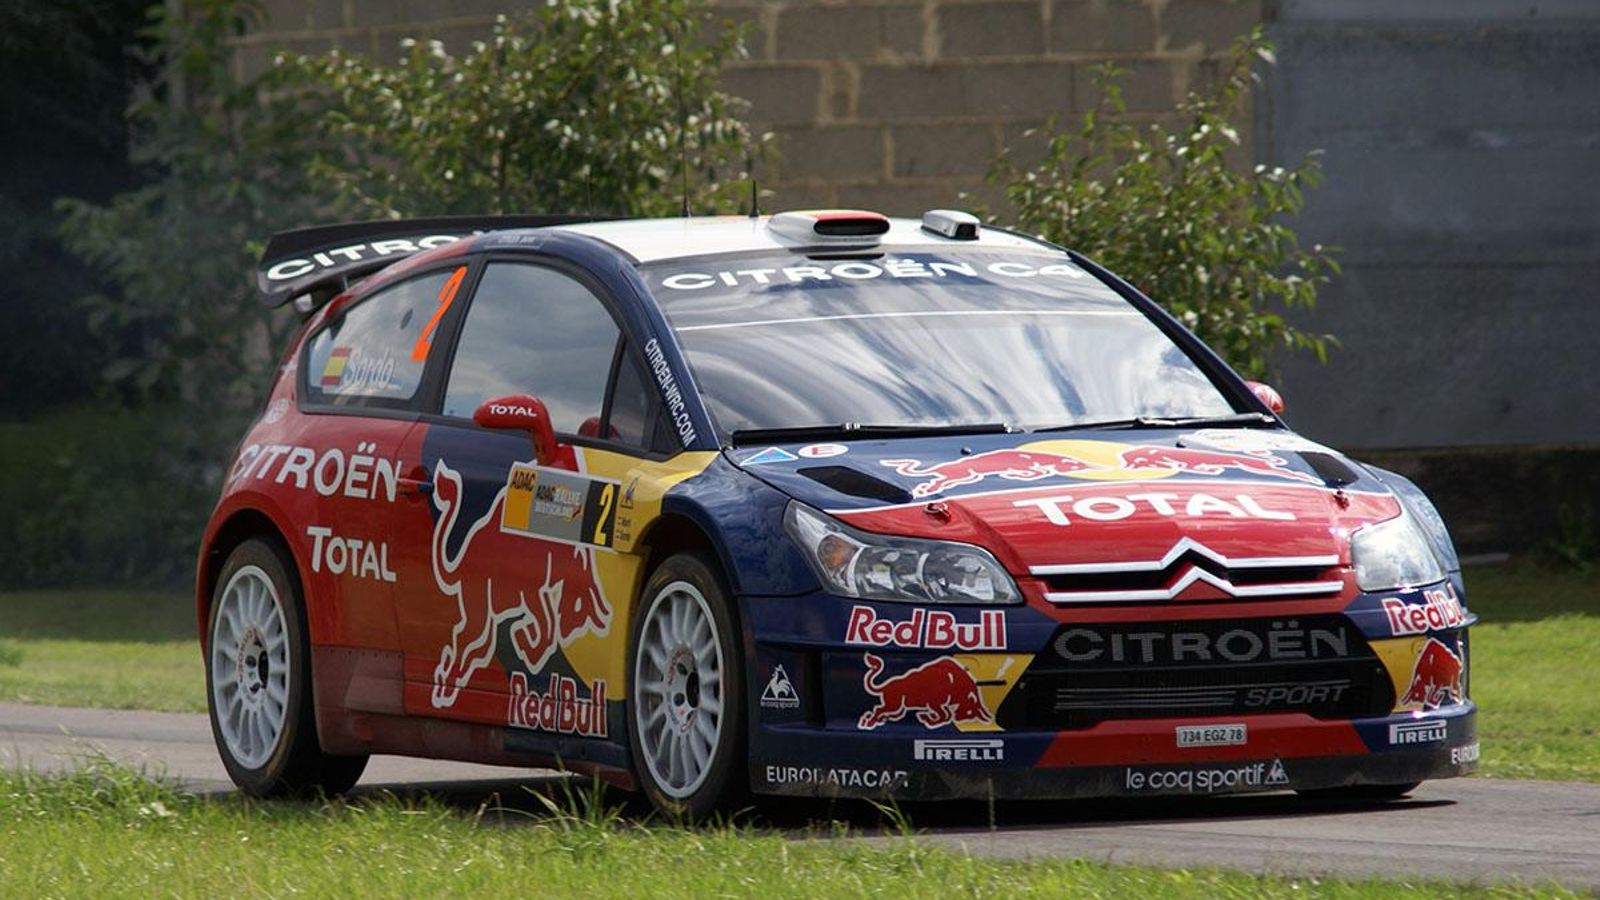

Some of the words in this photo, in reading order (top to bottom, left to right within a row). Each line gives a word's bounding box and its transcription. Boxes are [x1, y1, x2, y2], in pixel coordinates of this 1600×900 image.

[662, 258, 979, 290] CITROËN
[987, 261, 1084, 280] C4
[410, 265, 468, 361] 2
[489, 404, 537, 417] TOTAL
[644, 338, 696, 448] CITROEN-WRC.COM
[229, 441, 402, 502] CITROËN
[593, 483, 614, 545] 2
[1014, 492, 1296, 526] TOTAL
[845, 605, 924, 648] Red
[924, 609, 1007, 650] Bull
[1382, 591, 1443, 636] Red
[1054, 620, 1348, 663] CITROËN
[508, 671, 559, 732] Red
[558, 677, 608, 738] Bull
[1244, 685, 1350, 706] SPORT
[914, 739, 1004, 760] PIRELLI
[1204, 729, 1227, 742] EGZ
[1229, 728, 1243, 741] 78
[1389, 719, 1448, 744] PIRELLI
[1126, 767, 1145, 789] le
[1149, 770, 1193, 792] coq
[1196, 763, 1265, 792] sportif
